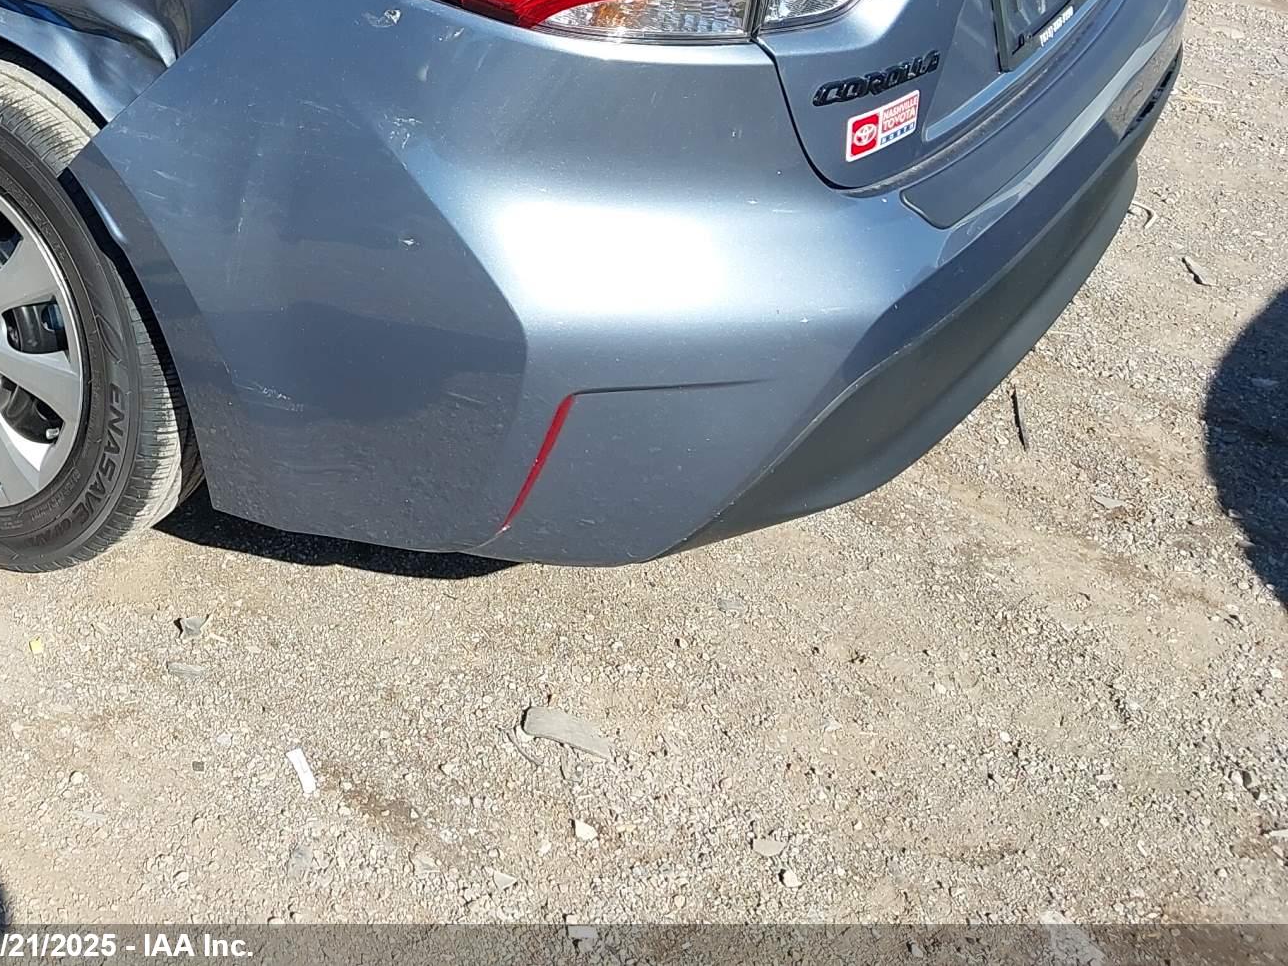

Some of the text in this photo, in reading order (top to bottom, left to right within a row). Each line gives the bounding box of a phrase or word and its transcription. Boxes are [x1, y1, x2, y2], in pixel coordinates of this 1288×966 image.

[812, 50, 940, 106] COROLLA
[882, 96, 919, 121] NASHVILLE
[882, 108, 917, 132] TOYOTA
[881, 123, 915, 144] NORTH
[71, 383, 125, 526] ENASAVE
